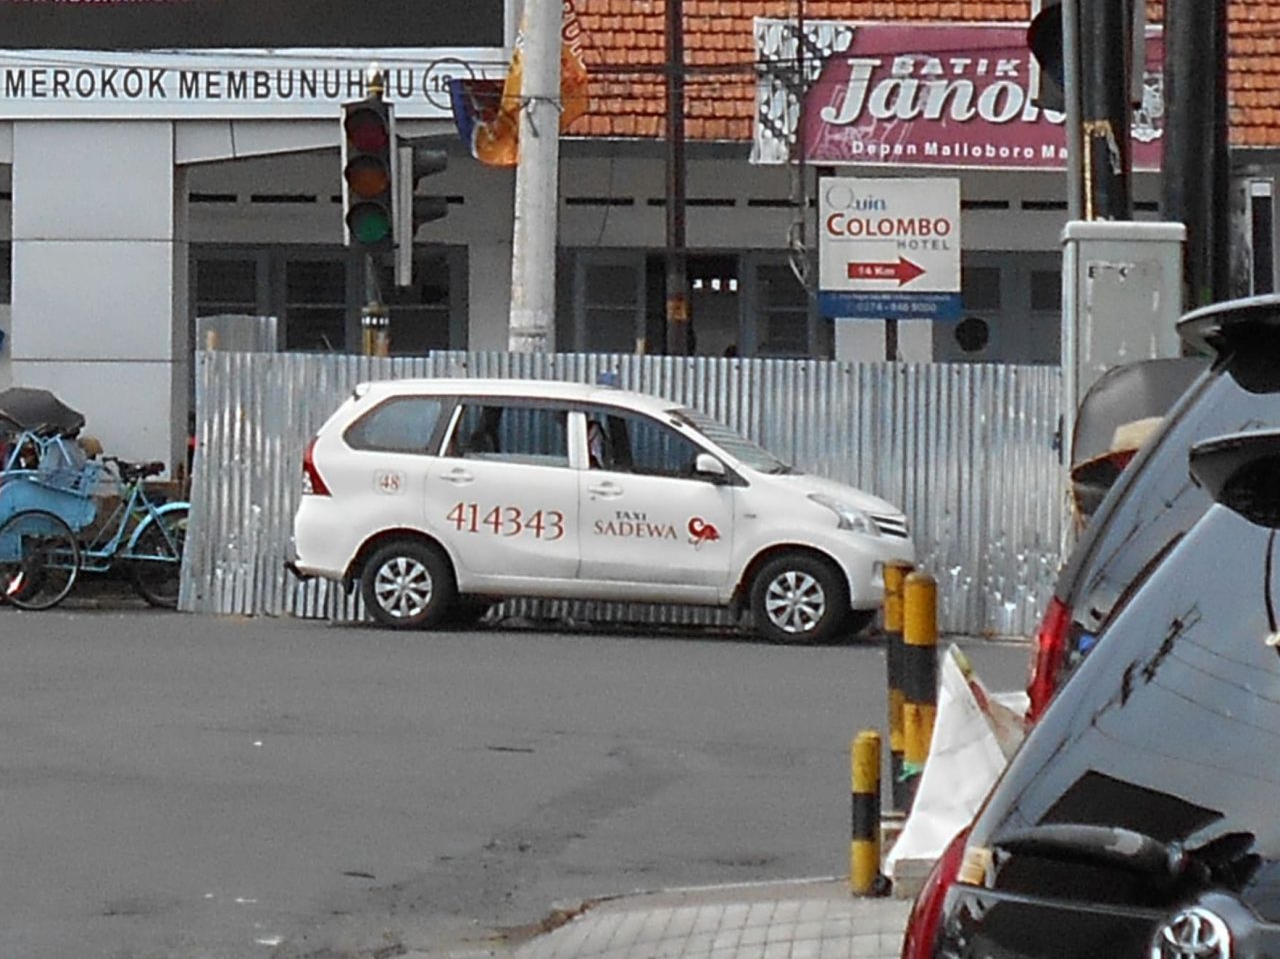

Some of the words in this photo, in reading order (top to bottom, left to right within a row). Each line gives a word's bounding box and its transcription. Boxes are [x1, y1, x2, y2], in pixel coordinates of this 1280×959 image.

[891, 57, 1022, 77] BATIK
[6, 68, 167, 98] MEROKOK
[821, 58, 1067, 124] Jano
[852, 141, 917, 159] Depan
[924, 142, 1034, 159] Malioboro
[1042, 145, 1068, 159] Ma
[826, 184, 887, 211] Quin
[897, 240, 950, 250] HOTEL
[378, 474, 400, 490] 48
[446, 501, 565, 541] 414343
[615, 510, 647, 522] TAXI
[594, 520, 678, 540] SADEWA
